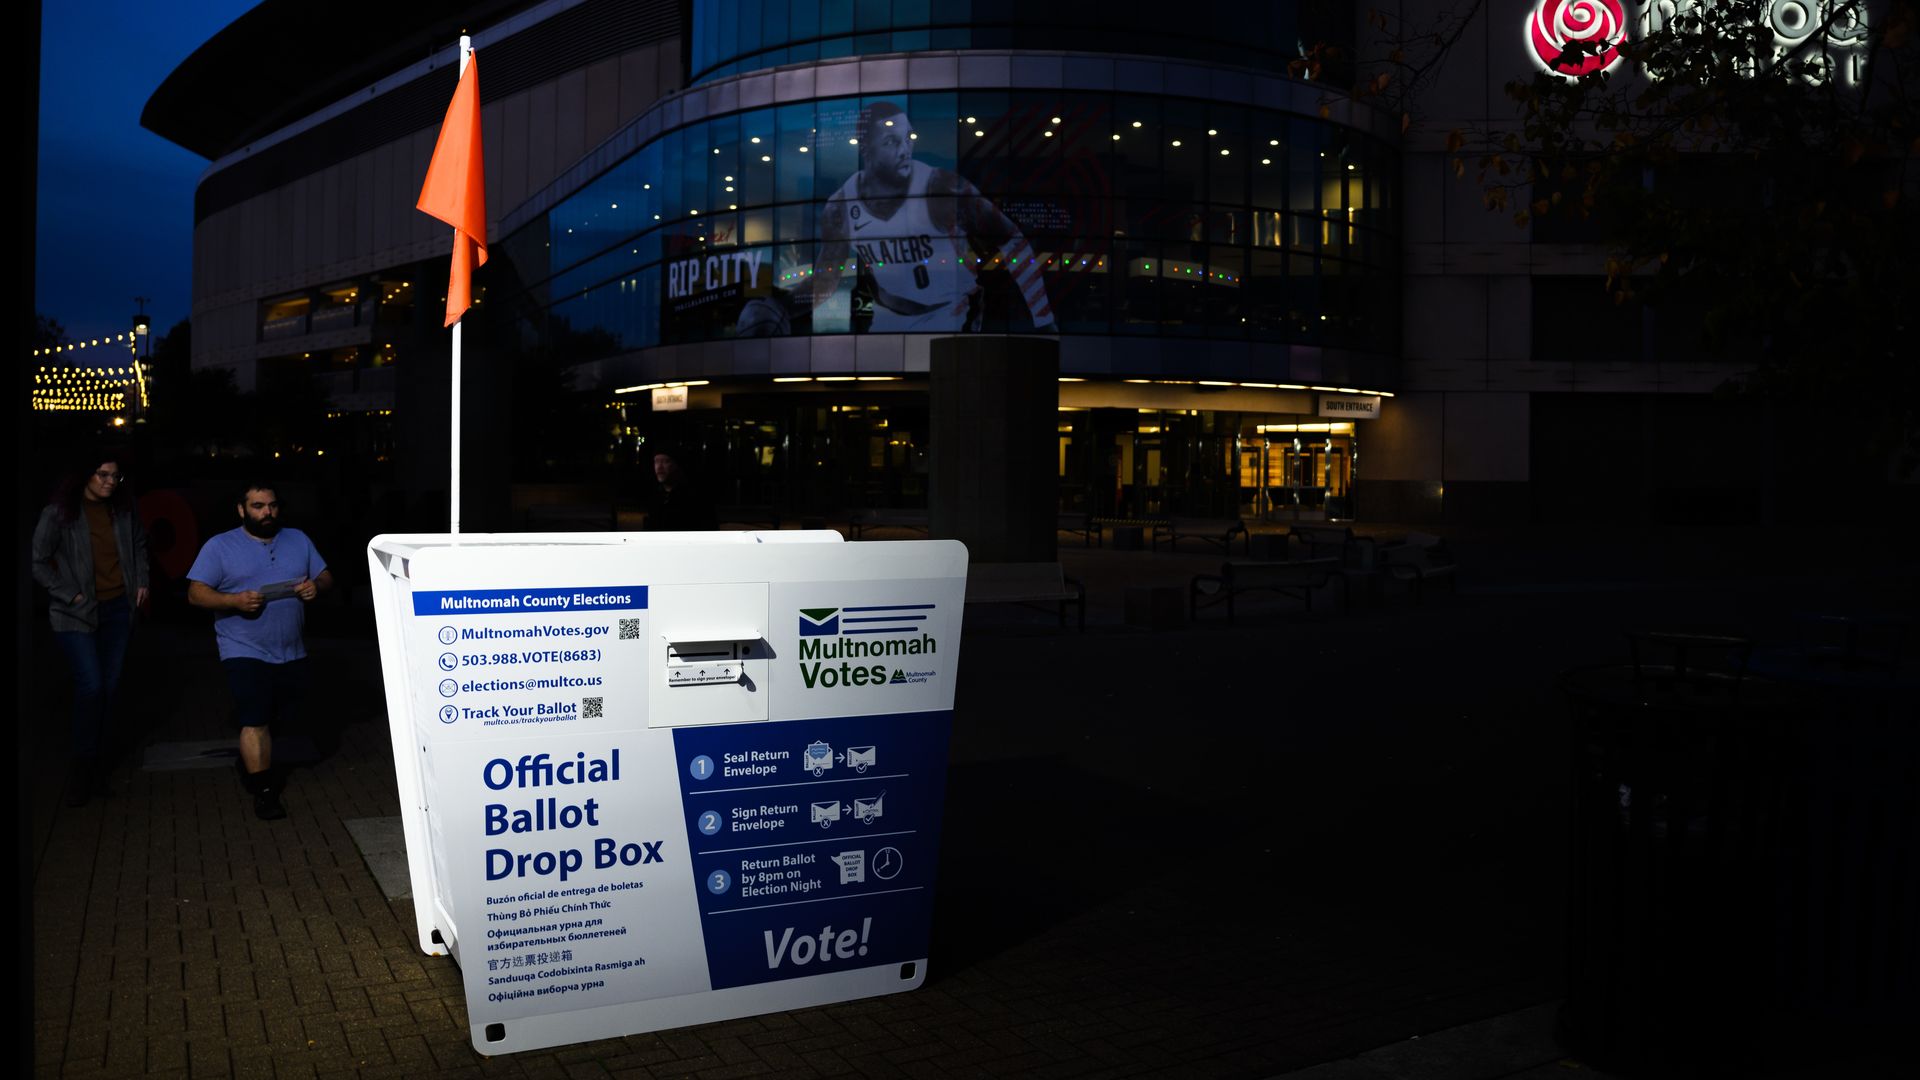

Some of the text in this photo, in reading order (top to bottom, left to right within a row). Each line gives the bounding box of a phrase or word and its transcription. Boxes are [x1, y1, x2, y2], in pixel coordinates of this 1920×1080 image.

[856, 234, 934, 265] BLAZERS
[669, 250, 762, 299] RIP CITY
[913, 264, 930, 290] 0
[1326, 401, 1373, 412] SOUTH ENTRANCE
[440, 593, 632, 610] Multnomah County Elections
[461, 624, 609, 640] MultnomahVotes.gov
[800, 634, 936, 660] Multnomah
[462, 649, 602, 666] 503.988.VOTE(8683)
[462, 676, 602, 693] elections@multco.us
[800, 662, 887, 689] Votes
[462, 702, 577, 720] Track Your Ballot
[484, 714, 577, 726] multco.us/trackyourballot
[724, 750, 790, 764] Seal Return
[483, 748, 620, 791] Official
[698, 759, 706, 774] 1
[724, 764, 777, 777] Envelope
[485, 798, 599, 836] Ballot
[731, 804, 798, 820] Sign Return
[704, 815, 716, 830] 2
[732, 818, 784, 832] Envelope
[486, 838, 664, 882] Drop Box
[742, 853, 816, 870] Return Ballot
[714, 874, 724, 890] 3
[742, 869, 801, 884] by 8pm on
[486, 880, 644, 905] Buzón oficial de entrega de boletas
[742, 879, 822, 897] Election Night
[488, 900, 612, 922] Thùng Bỏ Phiếu Chính Thức
[487, 918, 603, 939] Официальная урна для
[487, 926, 627, 952] избирательных бюллетеней
[764, 917, 872, 969] Vote!
[487, 950, 573, 971] 官方选票投递箱
[488, 958, 645, 986] Sanduuqa Codobixinta Rasmiga ah
[488, 980, 604, 1002] Офіційна виборча урна
